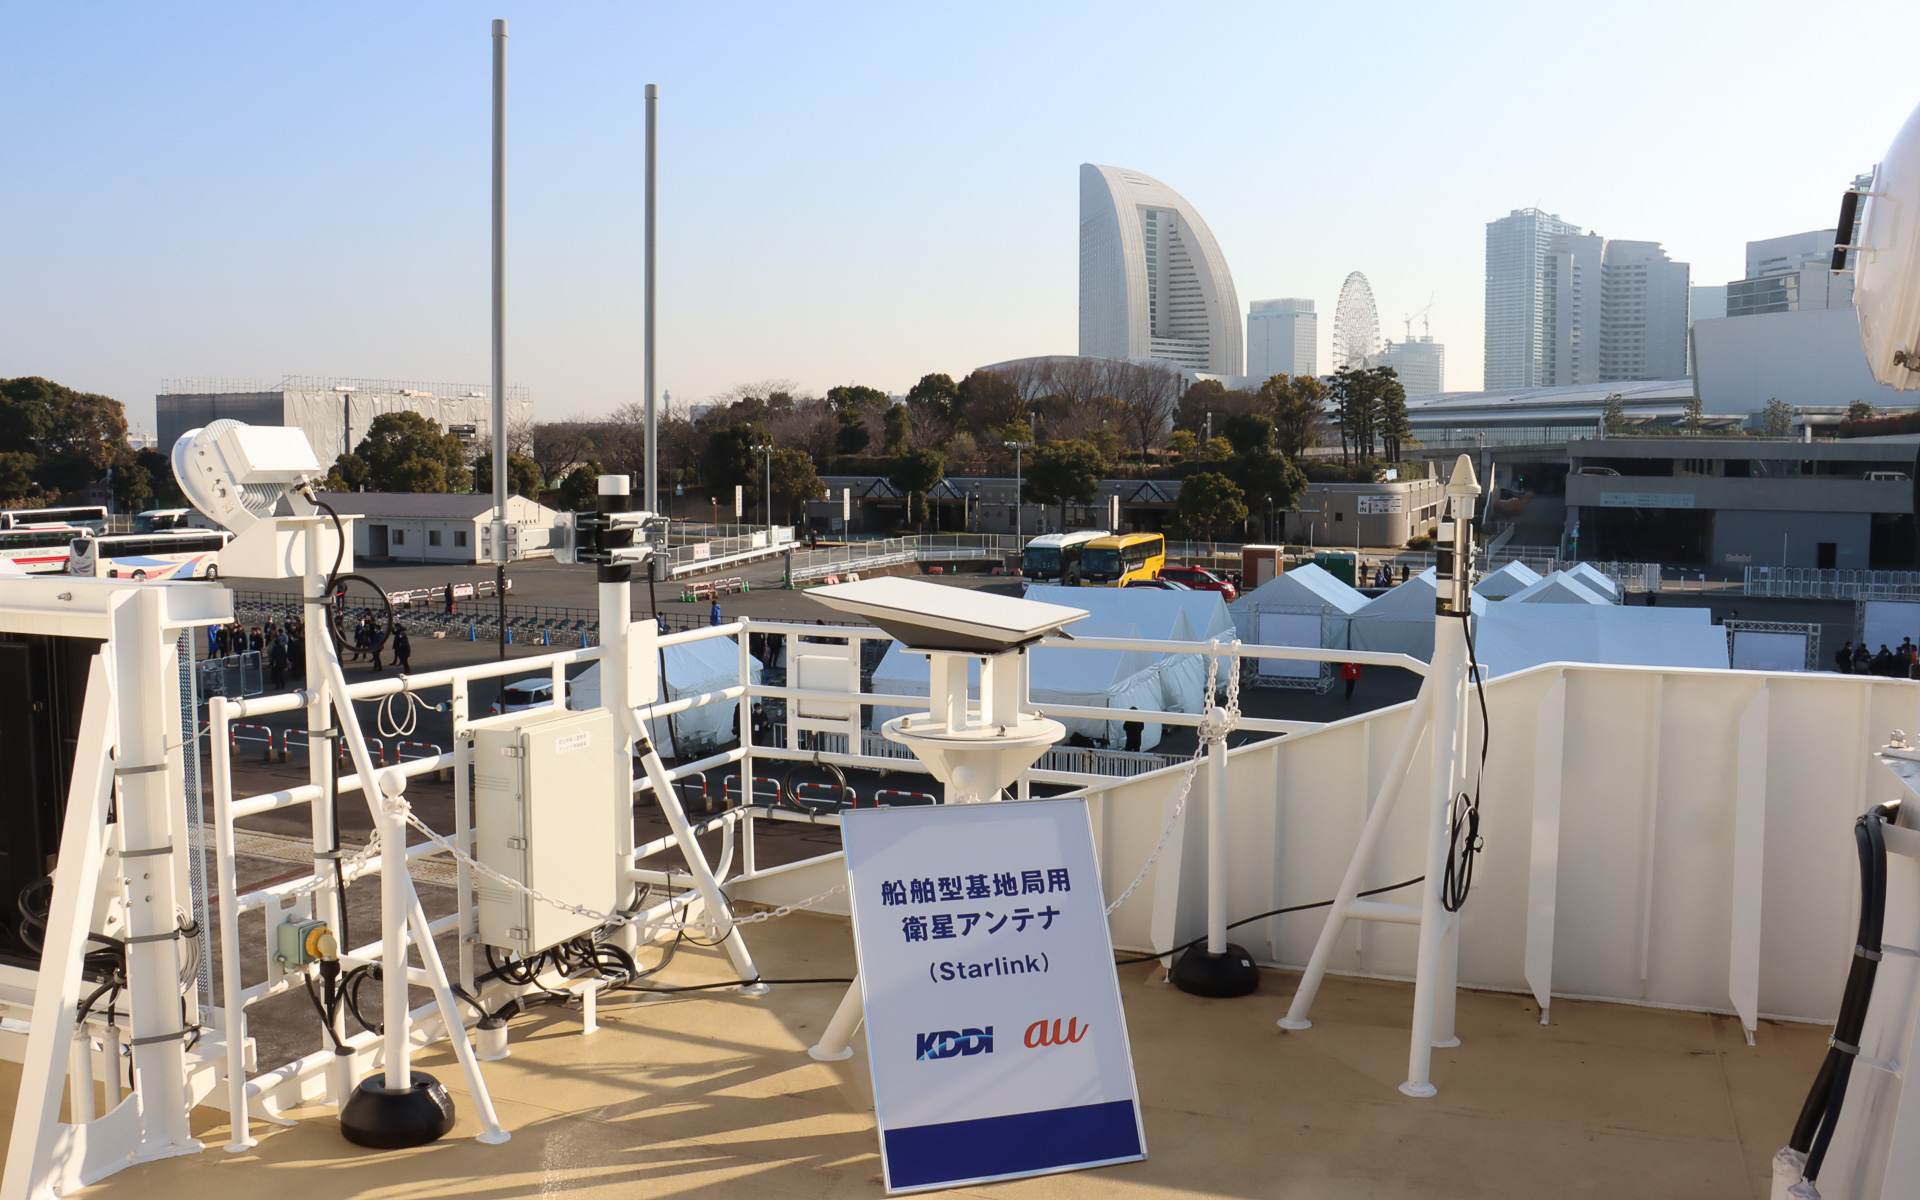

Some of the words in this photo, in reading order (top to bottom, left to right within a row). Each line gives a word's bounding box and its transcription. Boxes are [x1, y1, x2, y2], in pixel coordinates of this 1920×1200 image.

[24, 549, 50, 557] LIMOUSINE
[881, 868, 1071, 906] 船舶型基地局用
[902, 906, 1060, 942] 衛星アンテナ
[930, 952, 1049, 983] (Starlink)
[916, 1025, 994, 1061] KDDI
[1024, 1016, 1089, 1049] au
